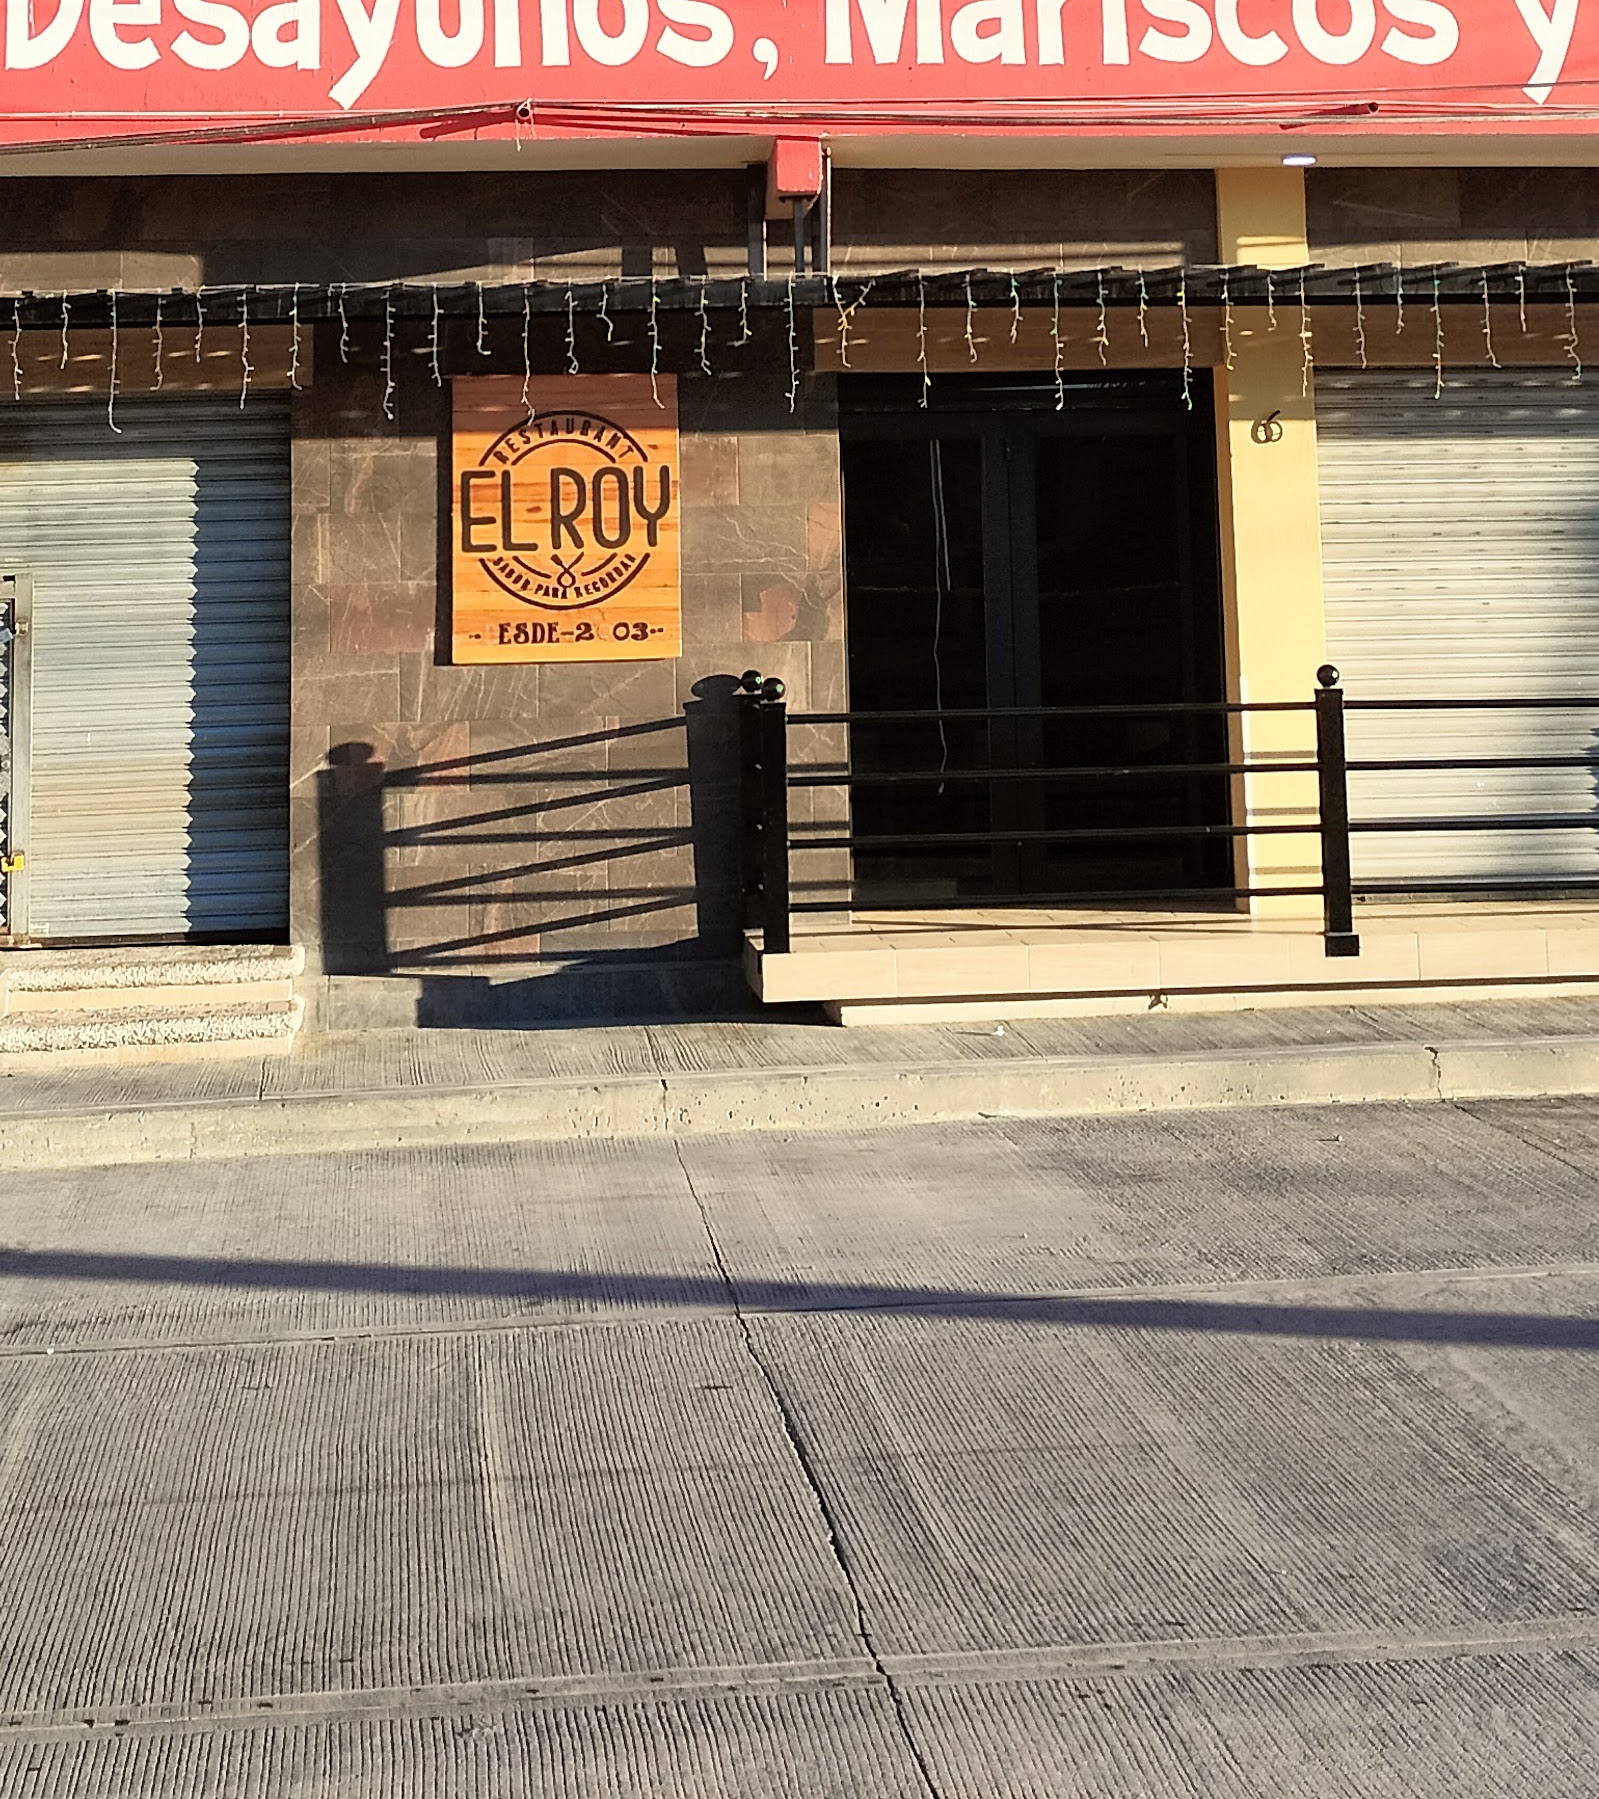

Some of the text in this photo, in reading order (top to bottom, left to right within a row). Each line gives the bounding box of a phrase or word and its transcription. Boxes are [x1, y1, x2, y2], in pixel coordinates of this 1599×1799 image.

[492, 417, 635, 466] RESTAURANT
[461, 465, 671, 553] EL ROY
[493, 556, 531, 591] SABOR
